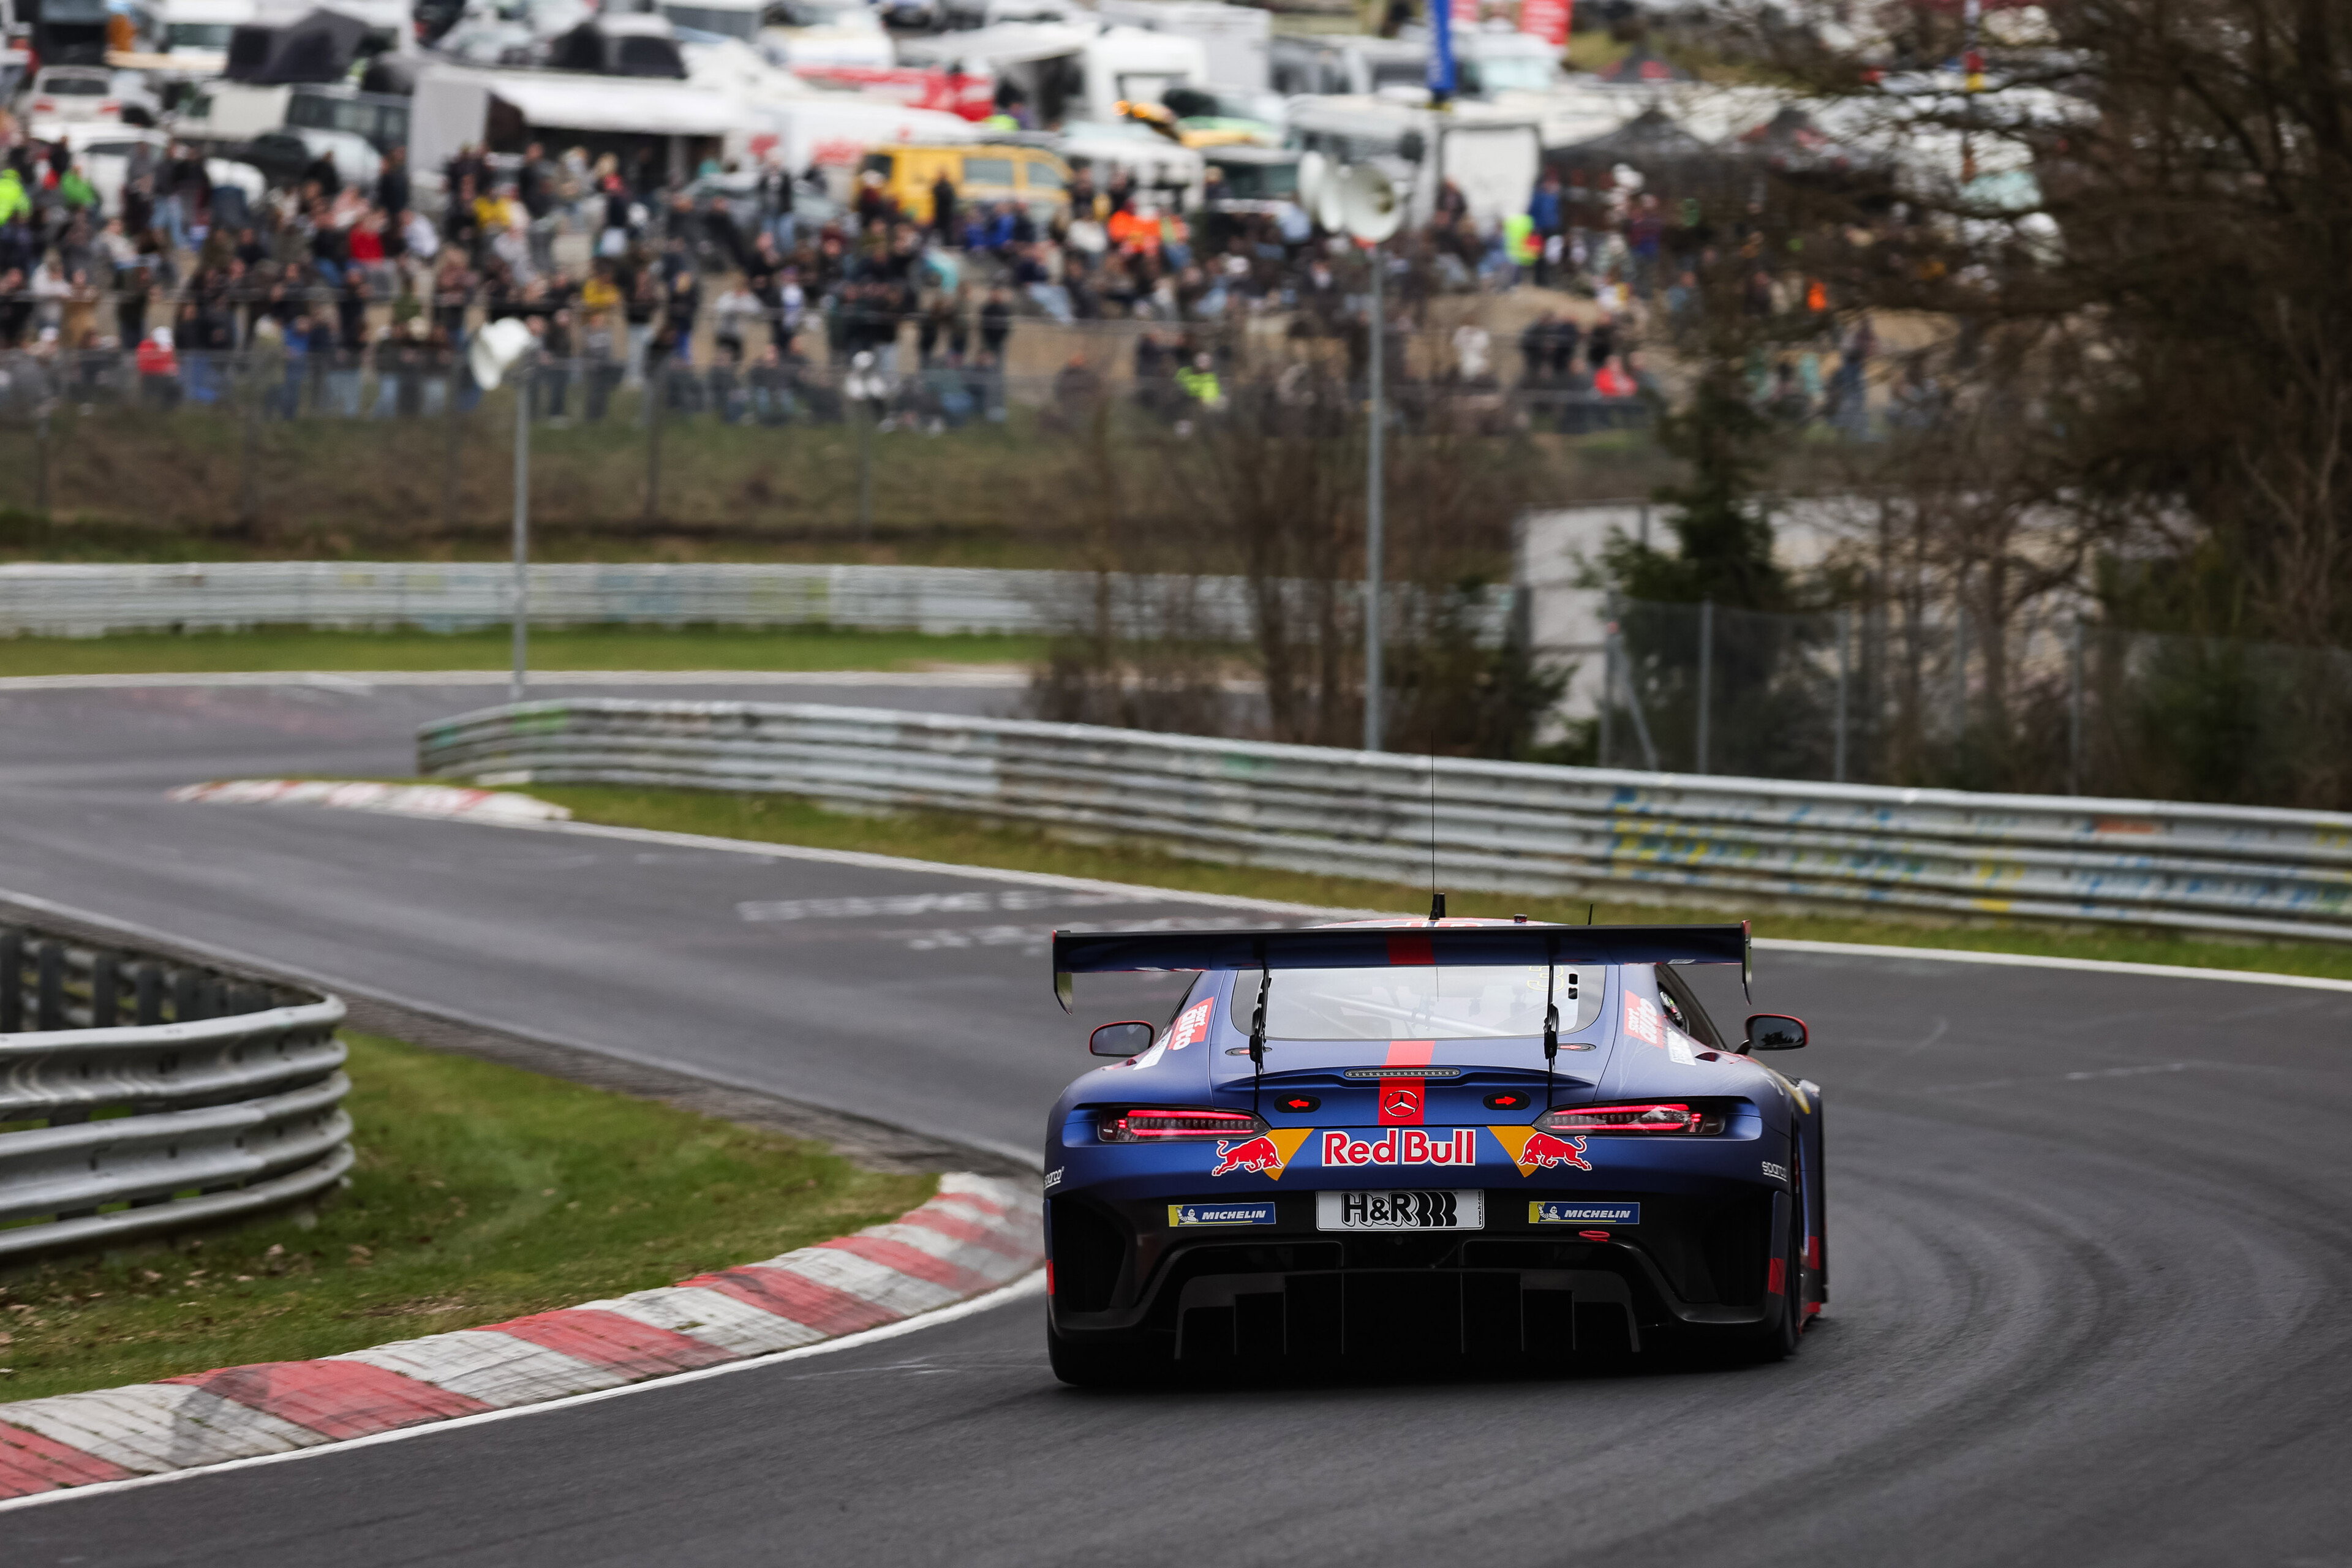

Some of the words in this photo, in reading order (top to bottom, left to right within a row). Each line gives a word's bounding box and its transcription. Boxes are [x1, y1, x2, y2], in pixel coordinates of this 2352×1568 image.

[1172, 1009, 1197, 1050] auto
[1194, 1005, 1208, 1027] sport
[1627, 1008, 1640, 1033] sport
[1638, 998, 1657, 1044] auto
[1322, 1129, 1398, 1166] Red
[1402, 1129, 1476, 1166] Bull
[1201, 1210, 1266, 1220] MICHELIN
[1341, 1192, 1419, 1227] H&R
[1564, 1210, 1631, 1218] MICHELIN
